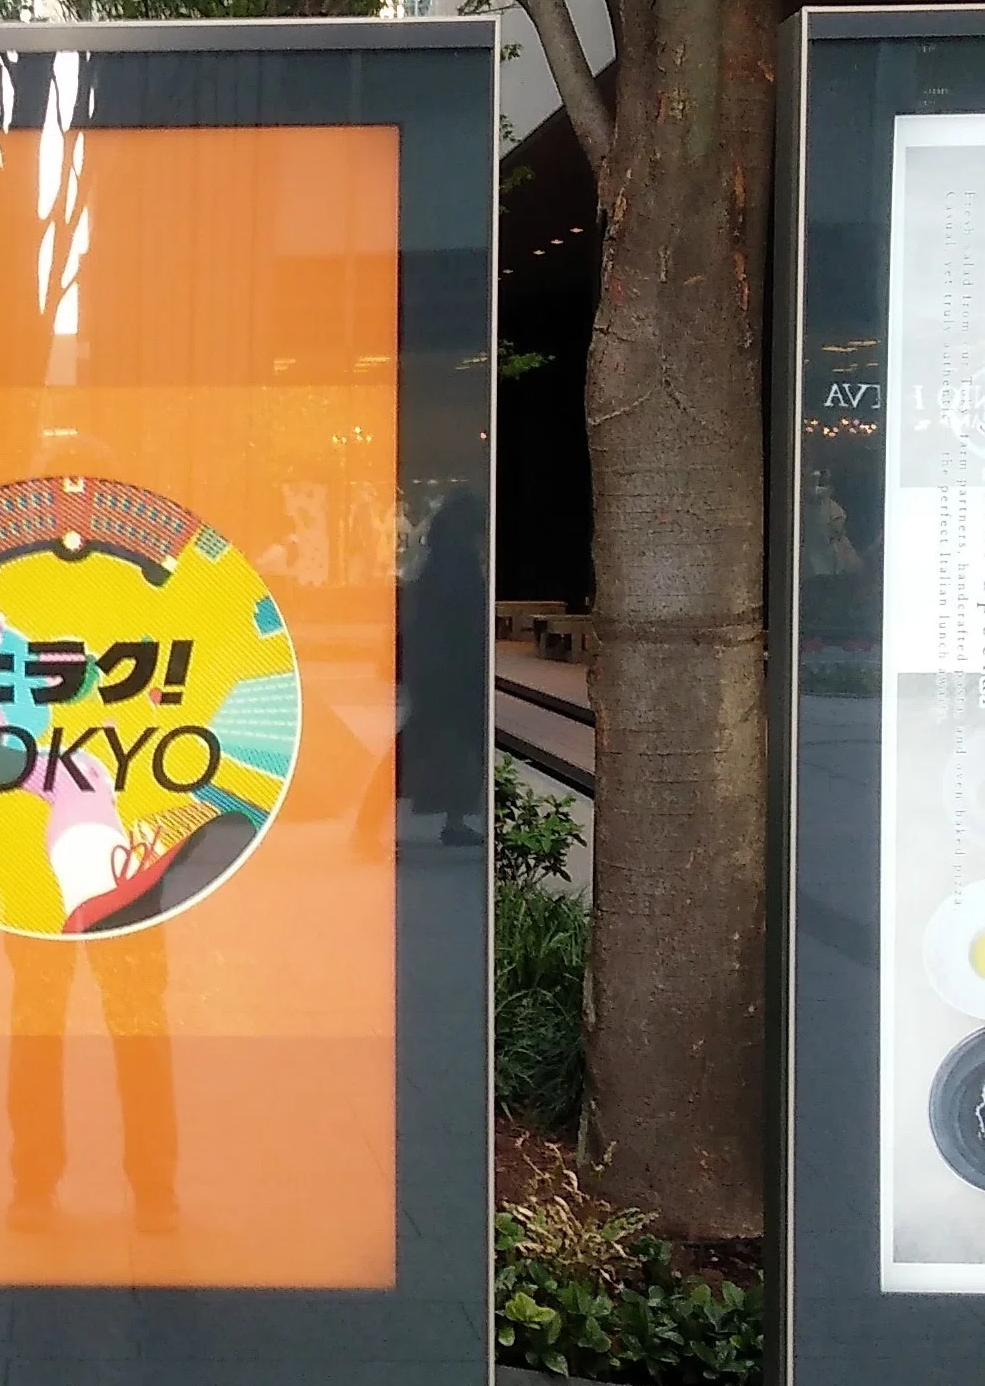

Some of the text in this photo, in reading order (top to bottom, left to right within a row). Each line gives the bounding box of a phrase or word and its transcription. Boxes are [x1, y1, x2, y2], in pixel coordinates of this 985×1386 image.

[942, 294, 955, 333] truly
[961, 294, 974, 333] from
[937, 486, 952, 544] perfect
[955, 479, 969, 555] partners,
[938, 552, 951, 607] Italian
[956, 562, 969, 662] handcrafted
[938, 615, 950, 659] lunch
[955, 727, 967, 755] and
